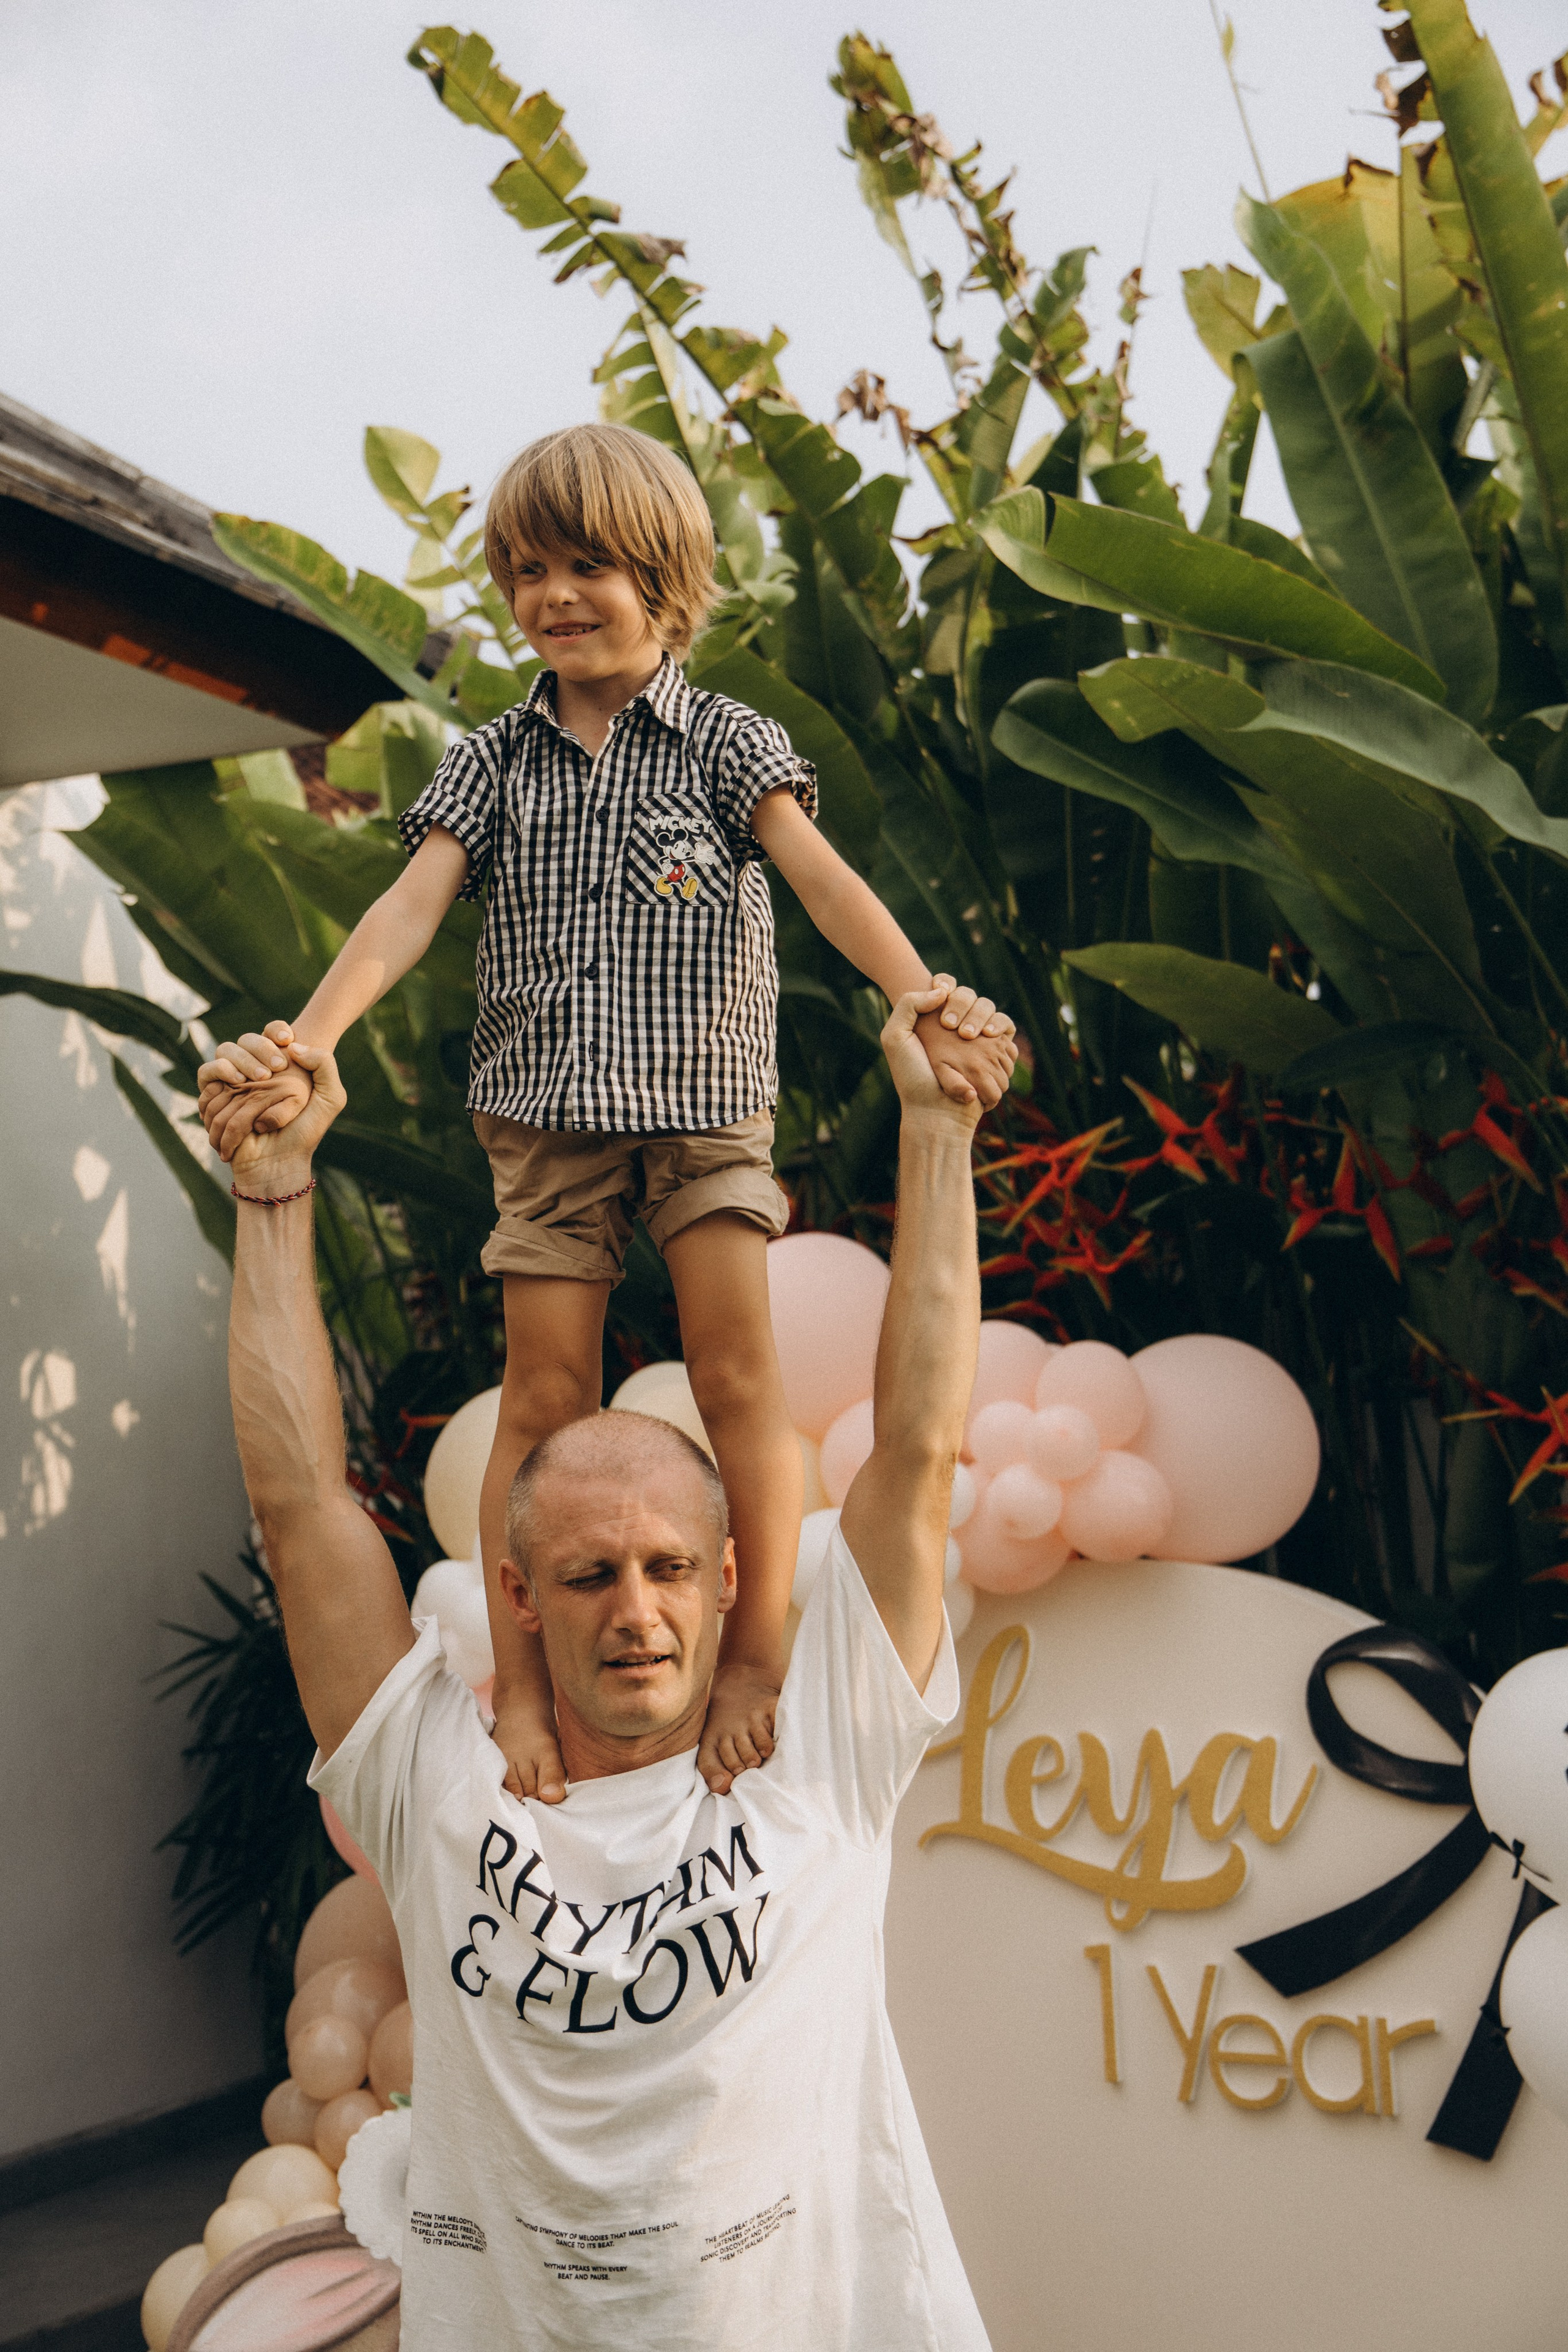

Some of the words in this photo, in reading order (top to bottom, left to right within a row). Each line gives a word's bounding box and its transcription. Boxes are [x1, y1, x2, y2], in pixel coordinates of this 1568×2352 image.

[648, 815, 713, 834] MICKEY
[918, 1624, 1317, 1932] Leya
[476, 1819, 765, 1956] RHYTHM
[450, 1913, 500, 1997] &
[515, 1890, 771, 2034] FLOW
[1083, 1943, 1120, 2085] 1
[1146, 1964, 1436, 2117] Year
[410, 2218, 432, 2228] RHYTHM
[460, 2226, 477, 2236] FREELY,
[413, 2211, 432, 2220] WITHIN
[448, 2215, 473, 2226] MELODY'S
[539, 2227, 568, 2238] SYMPHONY
[662, 2222, 678, 2230] SOUL
[705, 2236, 717, 2245] THE
[718, 2220, 747, 2239] HEARTBEAT
[749, 2215, 755, 2224] OF
[756, 2207, 772, 2219] MUSIC
[556, 2239, 575, 2248] DANCE
[700, 2250, 718, 2262] SONIC
[720, 2236, 748, 2254] DISCOVERY
[750, 2229, 762, 2239] AND
[714, 2231, 742, 2248] LISTENERS
[719, 2252, 735, 2263] THEM
[745, 2236, 763, 2249] REALMS
[544, 2262, 566, 2271] RHYTHM
